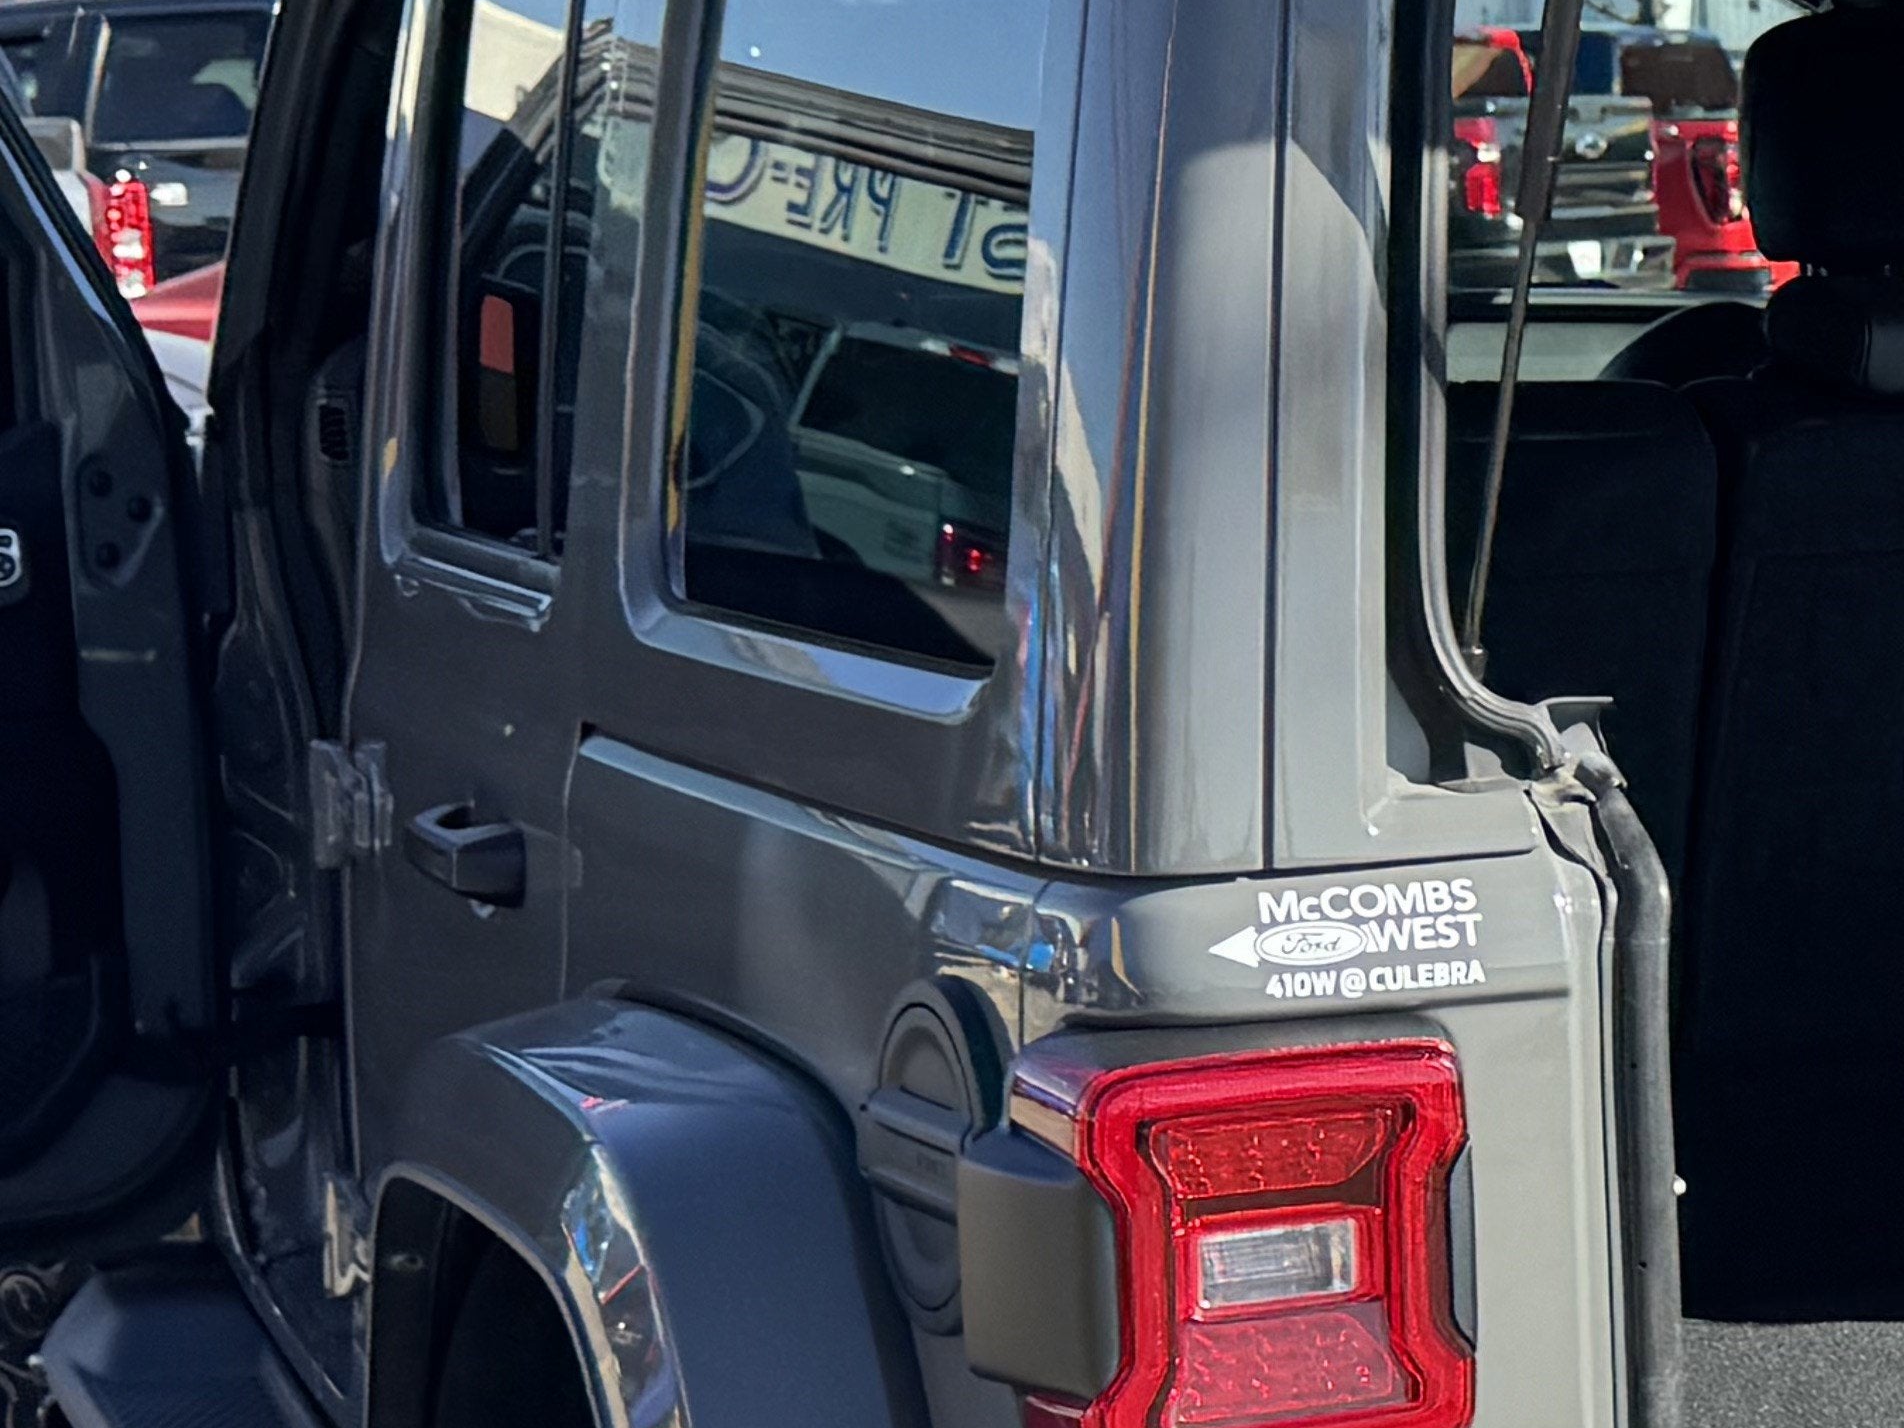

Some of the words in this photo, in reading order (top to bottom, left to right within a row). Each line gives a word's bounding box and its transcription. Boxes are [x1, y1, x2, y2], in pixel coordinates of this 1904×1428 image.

[1257, 878, 1479, 924] McCOMBS
[1281, 930, 1343, 956] Ford
[1369, 912, 1484, 953] WEST
